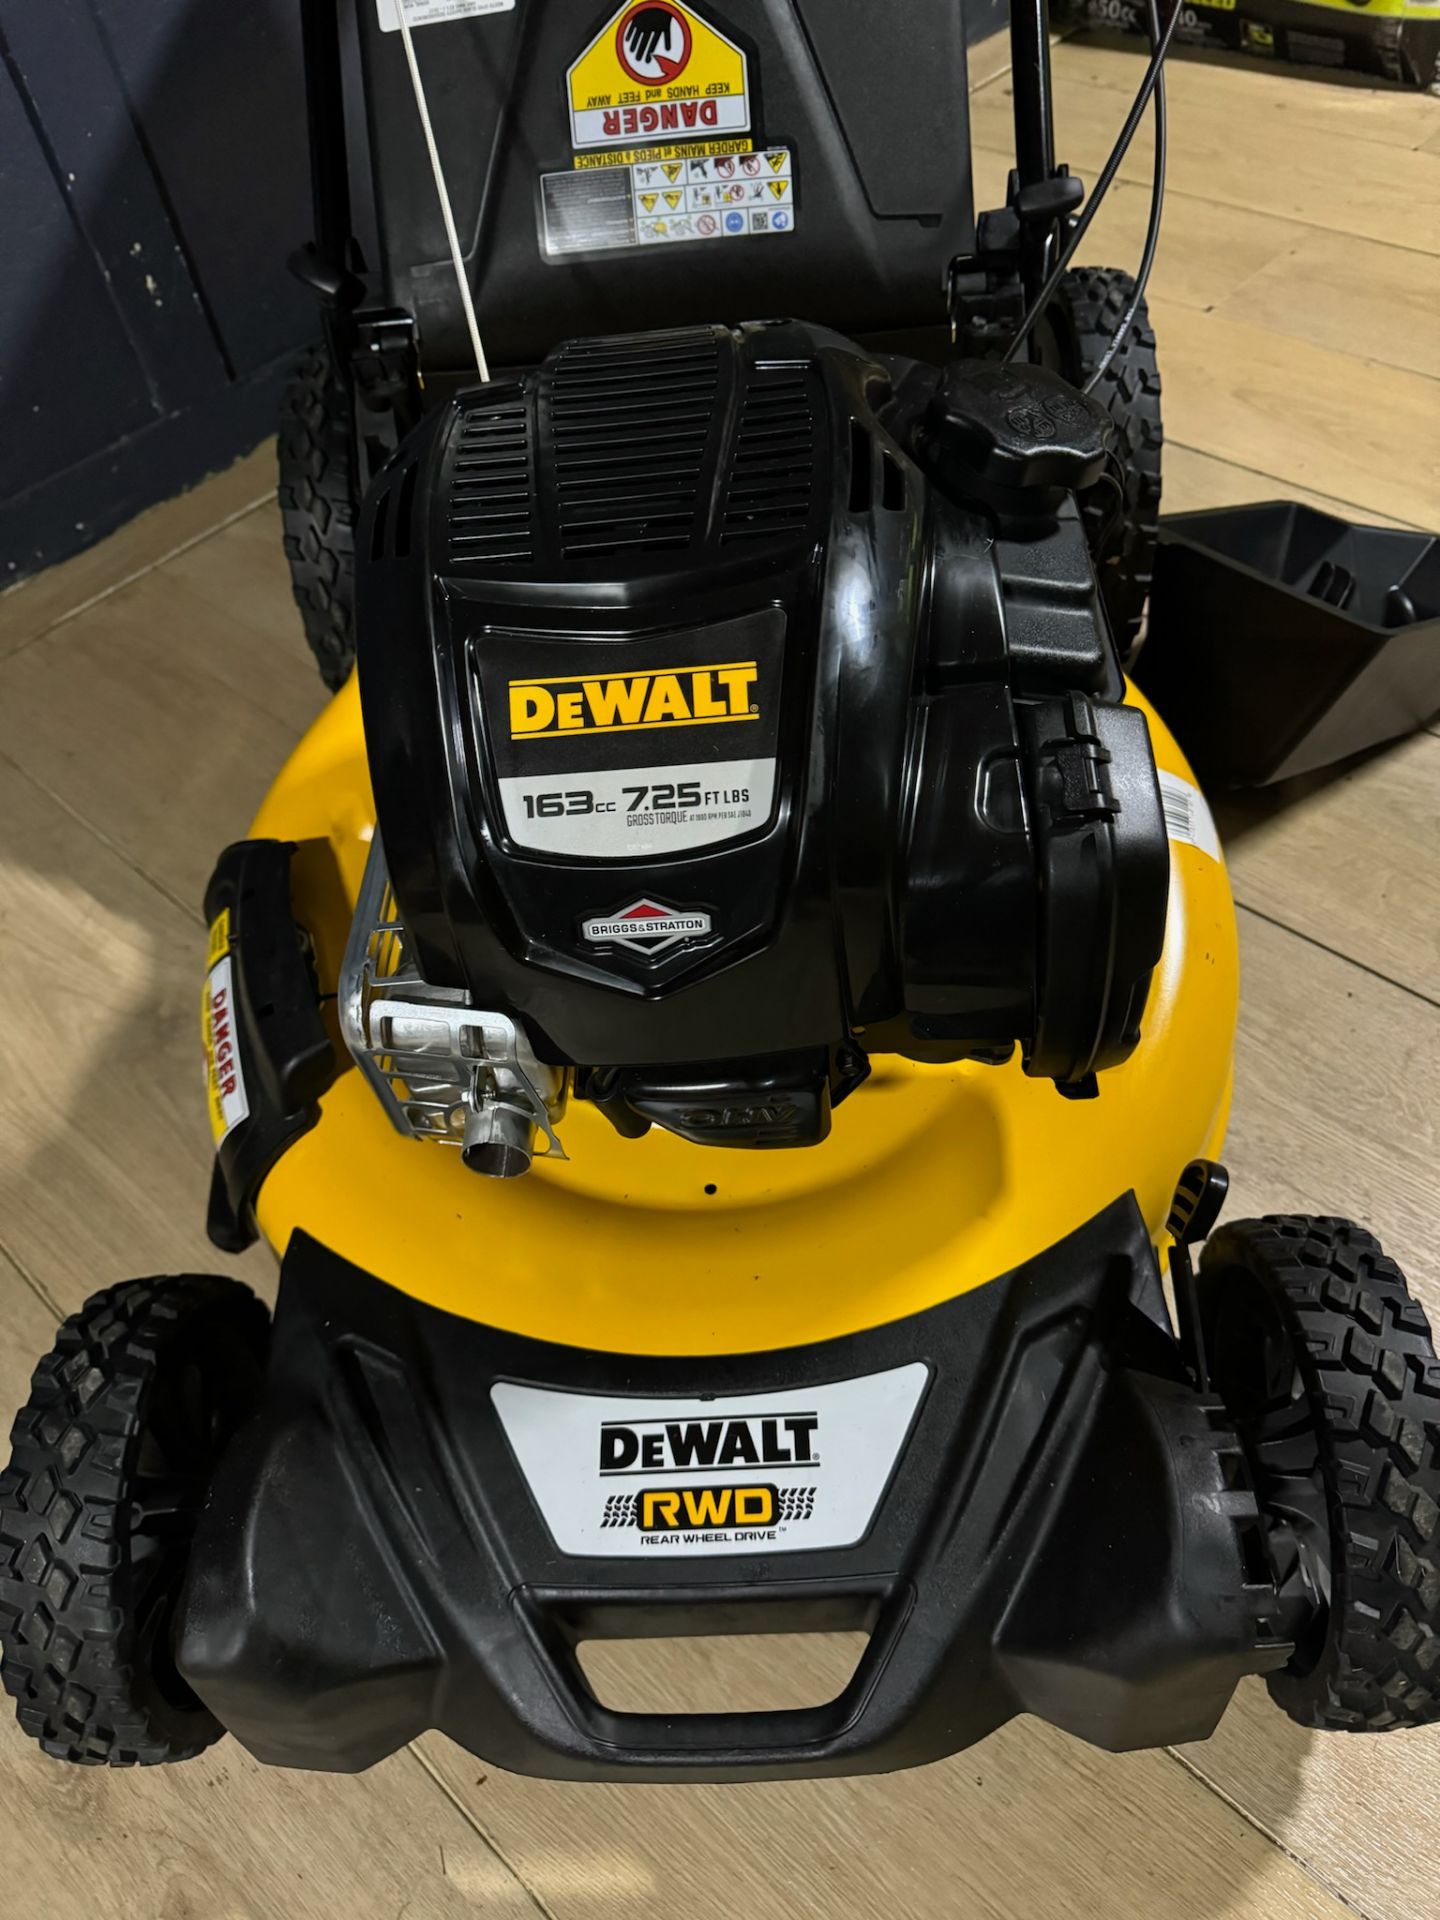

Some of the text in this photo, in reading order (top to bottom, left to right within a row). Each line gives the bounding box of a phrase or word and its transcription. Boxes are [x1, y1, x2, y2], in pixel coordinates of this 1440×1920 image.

[586, 82, 730, 108] KEEP HANDS and FEET AWAY
[603, 100, 718, 136] DANGER
[634, 148, 661, 163] PIEDS
[664, 149, 673, 158] et
[675, 144, 709, 158] MAINS
[710, 140, 748, 154] GARDER
[577, 151, 624, 168] DISTANCE
[509, 667, 758, 734] DEWALT
[622, 782, 701, 812] 7.25
[704, 791, 720, 806] FT
[724, 788, 749, 804] LBS
[626, 812, 655, 827] GROSS
[655, 810, 688, 825] TORQUE
[211, 988, 237, 1100] DANGER
[600, 1417, 819, 1470] DEWALT
[643, 1487, 773, 1528] RWD
[640, 1530, 776, 1545] REAR WHEEL DRIVE
